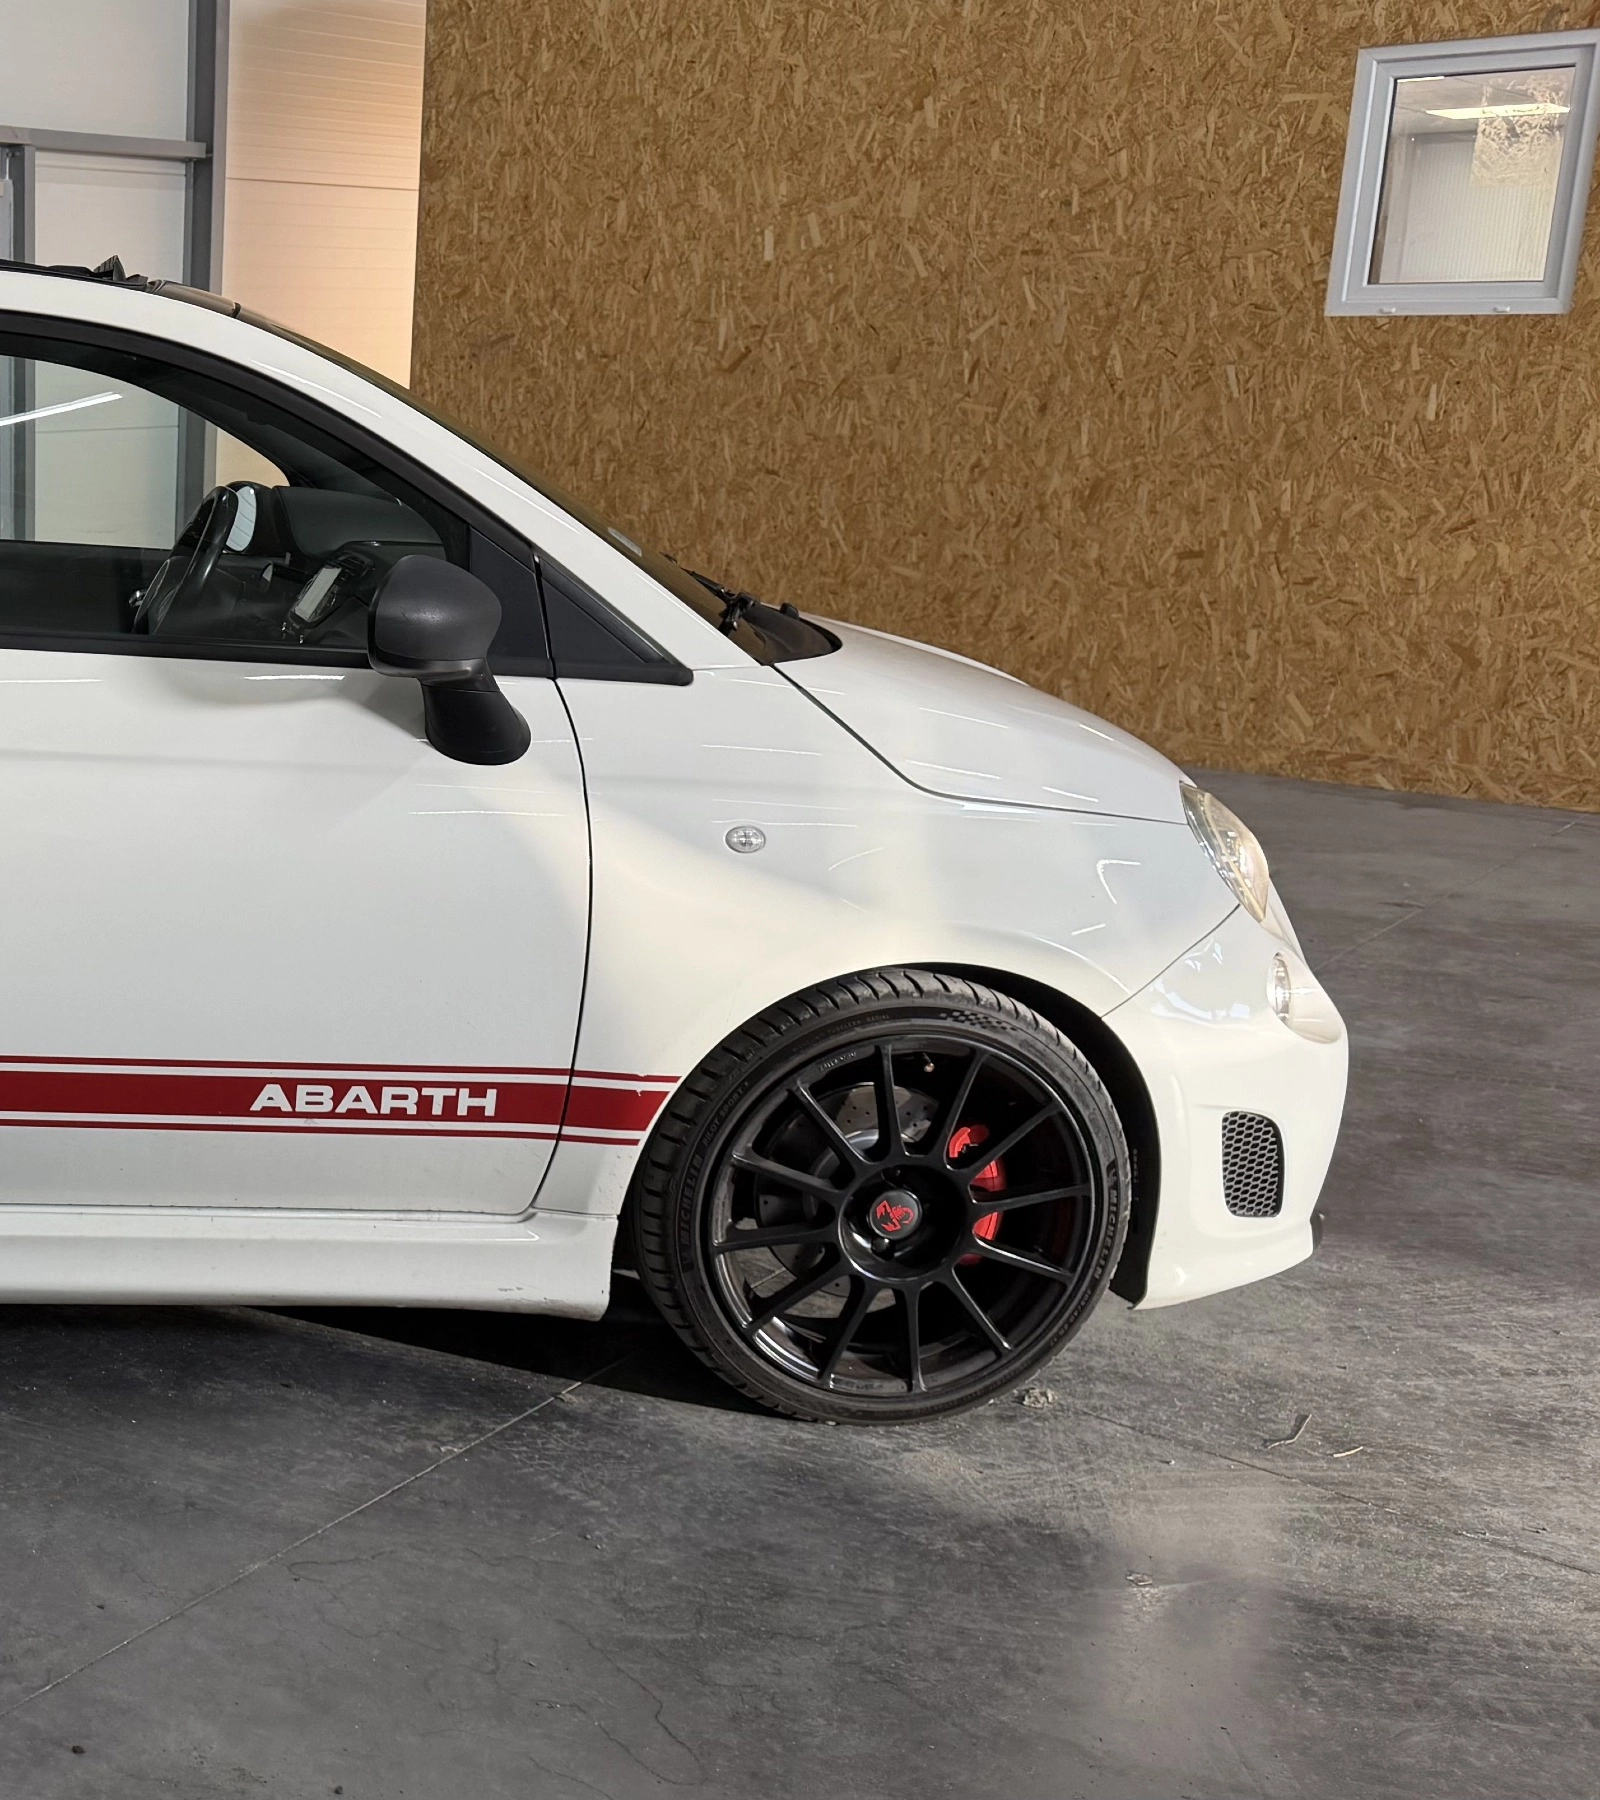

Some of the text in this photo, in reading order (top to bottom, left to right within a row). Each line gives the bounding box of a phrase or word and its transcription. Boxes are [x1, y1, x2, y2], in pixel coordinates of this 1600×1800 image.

[250, 1083, 497, 1117] ABARTH
[680, 1088, 744, 1246] MICHELIN PILOT SPORT
[1095, 1188, 1118, 1280] MICHELIN
